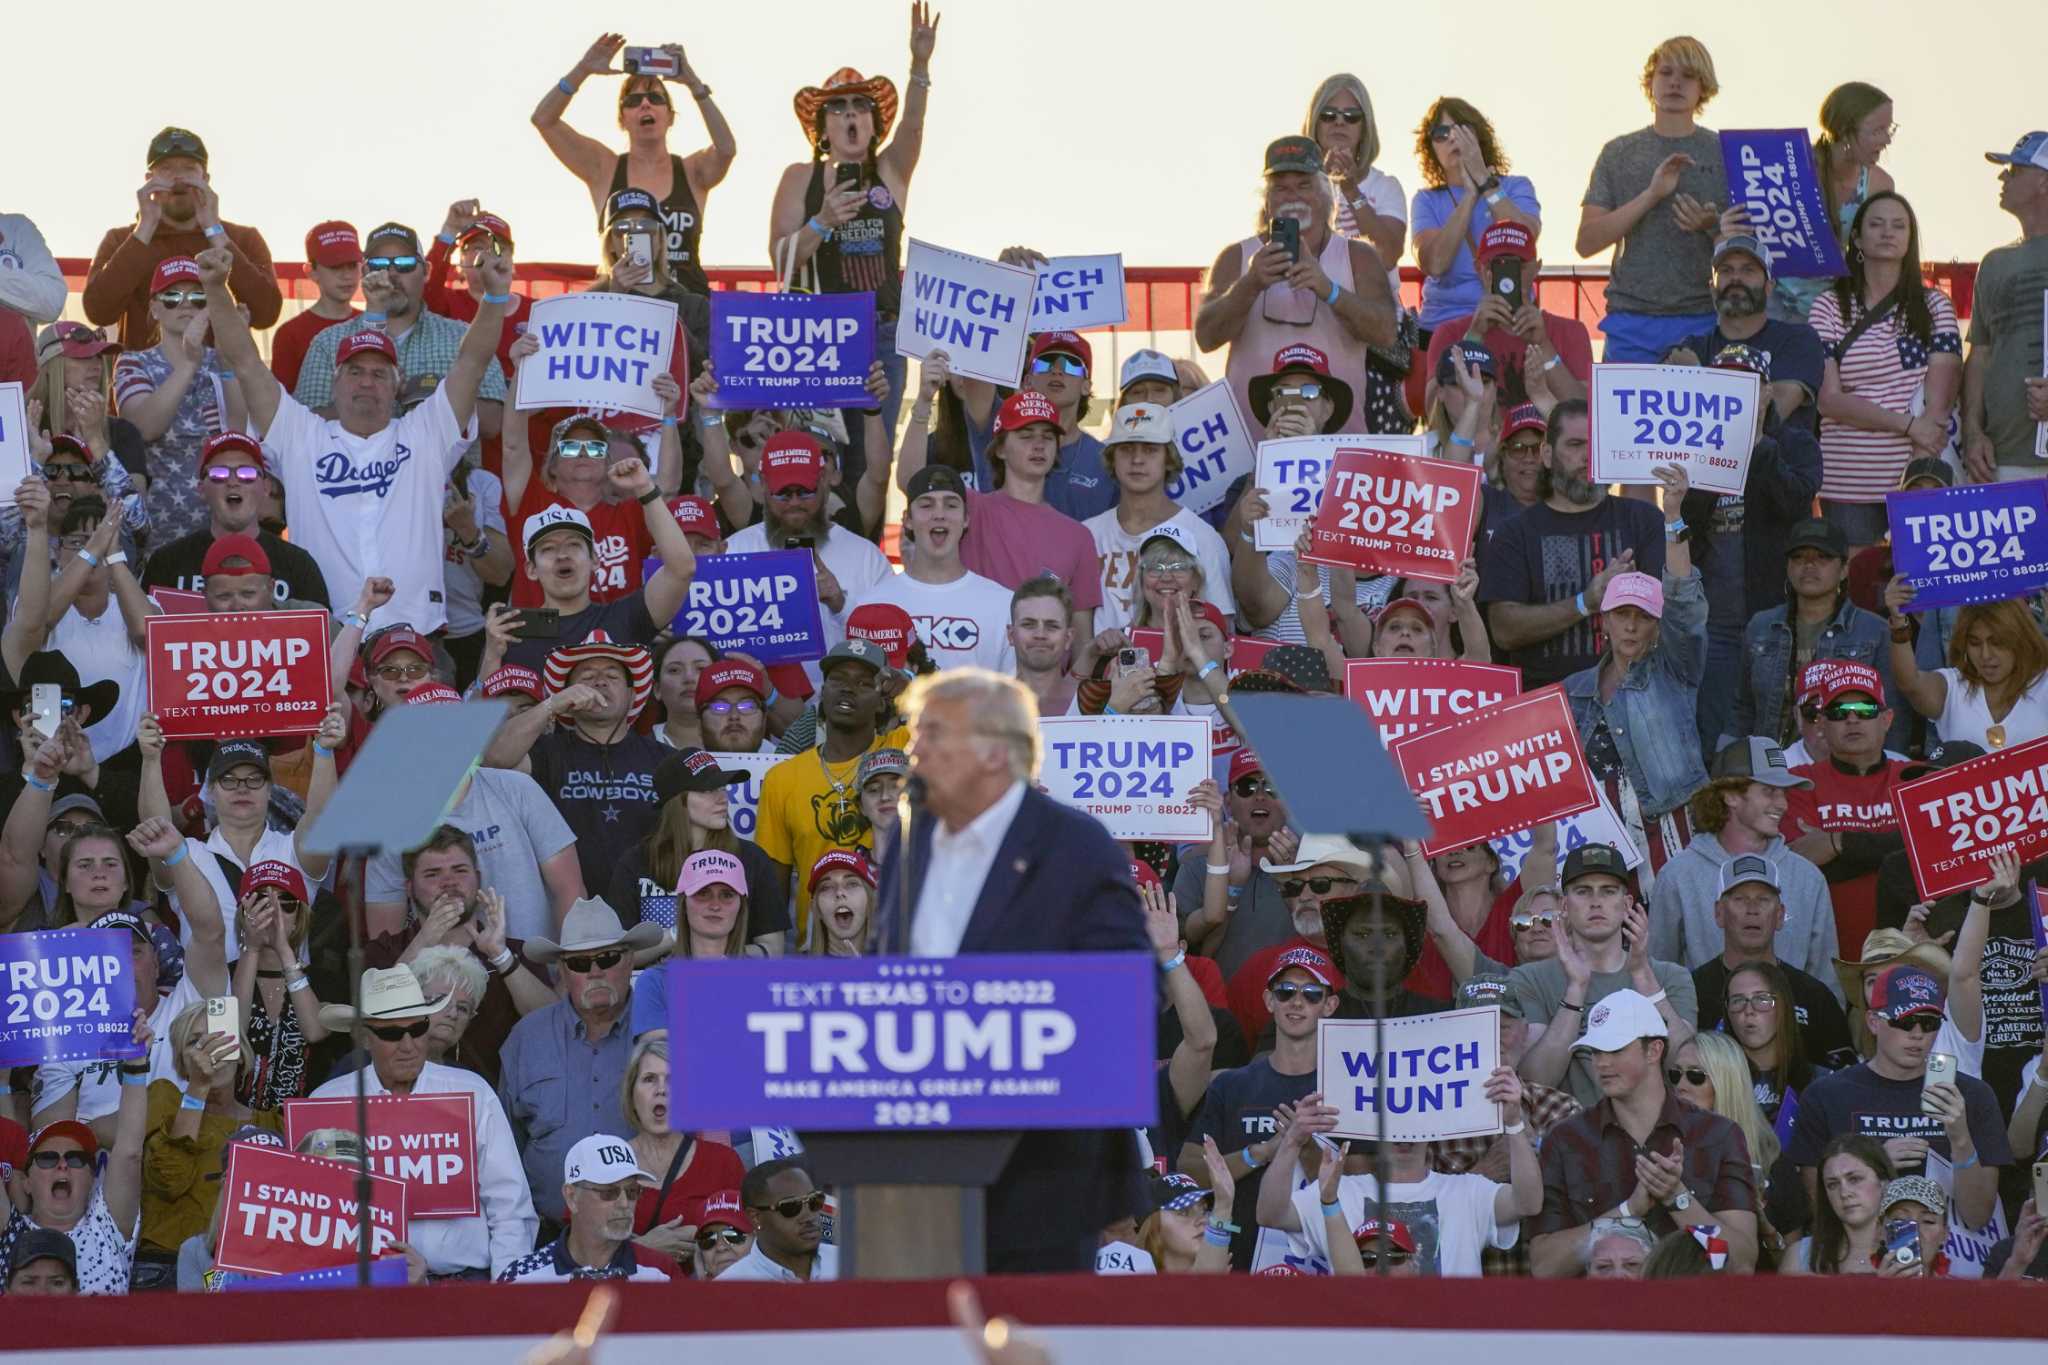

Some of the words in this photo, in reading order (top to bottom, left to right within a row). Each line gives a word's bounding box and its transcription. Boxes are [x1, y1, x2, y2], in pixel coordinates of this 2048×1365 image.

[1740, 145, 1788, 260] TRUMP
[1789, 179, 1802, 200] TO
[1764, 162, 1806, 248] 2024
[1036, 268, 1105, 292] TCH
[914, 271, 1016, 323] WITCH
[541, 321, 660, 355] WITCH
[726, 315, 859, 344] TRUMP
[915, 307, 999, 352] HUNT
[548, 355, 649, 386] HUNT
[744, 345, 840, 373] 2024
[722, 376, 754, 386] TEXT
[758, 376, 800, 386] TRUMP
[804, 376, 821, 386] TO
[825, 375, 863, 386] 88022
[1014, 399, 1055, 414] AMERICA
[1612, 389, 1743, 422] TRUMP
[1633, 418, 1724, 450] 2024
[785, 448, 812, 458] AMERICA
[1611, 450, 1642, 461] TEXT
[1647, 450, 1690, 462] TRUMP
[1694, 453, 1707, 464] TO
[1708, 456, 1739, 469] 88022
[1166, 447, 1226, 500] UNT
[1334, 471, 1461, 513] TRUMP
[538, 511, 574, 526] USA
[674, 507, 705, 518] AMERICA
[1339, 502, 1435, 541] 2024
[1905, 505, 2037, 544] TRUMP
[1153, 527, 1182, 537] USA
[1316, 530, 1346, 544] TEXT
[1349, 535, 1392, 551] TRUMP
[1395, 542, 1412, 554] TO
[1415, 545, 1456, 561] 88022
[1926, 536, 2026, 573] 2024
[688, 574, 798, 609] RUMP
[1909, 576, 1941, 589] TEXT
[1944, 571, 1989, 585] TRUMP
[1992, 568, 2009, 579] TO
[685, 604, 784, 637] 2024
[848, 626, 867, 638] MAKE
[867, 628, 903, 639] AMERICA
[164, 638, 311, 671] TRUMP
[710, 638, 746, 650] RUMP
[749, 635, 767, 646] TO
[769, 632, 809, 643] 88022
[186, 669, 293, 701] 2024
[484, 674, 503, 687] MAKE
[503, 667, 538, 681] AMERICA
[1823, 669, 1844, 683] MAKE
[1844, 665, 1877, 681] AMERICA
[1828, 676, 1850, 691] GREAT
[1850, 675, 1875, 689] AGAIN
[164, 706, 197, 718] TEXT
[202, 704, 249, 716] TRUMP
[253, 702, 272, 714] TO
[275, 700, 318, 712] 88022
[408, 690, 432, 705] MAKE
[1365, 688, 1503, 717] WITCH
[1052, 741, 1194, 769] TRUMP
[1430, 750, 1499, 783] STAND
[1504, 729, 1563, 759] WITH
[568, 770, 654, 788] DALLAS
[1072, 771, 1174, 799] 2024
[1420, 751, 1573, 820] TRUMP
[560, 785, 660, 803] COWBOYS
[1087, 805, 1132, 816] TRUMP
[1137, 805, 1153, 815] TO
[1157, 804, 1198, 816] 88022
[1818, 802, 1892, 820] TRUM
[1947, 796, 2048, 853] 2024
[691, 856, 737, 870] TRUMP
[1932, 855, 1966, 874] TEXT
[1968, 841, 2016, 863] TRUMP
[2018, 833, 2037, 848] TO
[91, 912, 138, 929] TRUMP
[2003, 943, 2037, 961] TRUM
[6, 987, 111, 1024] 2024
[768, 983, 833, 1007] TEXT
[841, 981, 928, 1006] TEXAS
[932, 981, 969, 1005] TO
[973, 980, 1055, 1005] 88022
[23, 1025, 72, 1039] TRUMP
[76, 1024, 94, 1035] TO
[97, 1022, 129, 1035] 88022
[1989, 1032, 2023, 1044] GREAT
[1997, 1022, 2043, 1033] AMERICA
[746, 1009, 1077, 1074] TRUMP
[1342, 1041, 1480, 1079] WITCH
[764, 1079, 821, 1099] MAKE
[826, 1079, 915, 1098] AMERICA
[919, 1078, 984, 1097] GREAT
[989, 1077, 1061, 1096] AGAIN!
[1355, 1080, 1470, 1113] HUNT
[875, 1100, 950, 1126] 2024
[400, 1132, 460, 1150] WITH
[597, 1145, 636, 1166] USA
[569, 1164, 580, 1179] 45
[244, 1181, 251, 1197] I
[257, 1185, 332, 1210] STAND
[338, 1199, 393, 1226] WTH
[239, 1203, 396, 1256] TRUMP
[1096, 1252, 1136, 1273] USA
